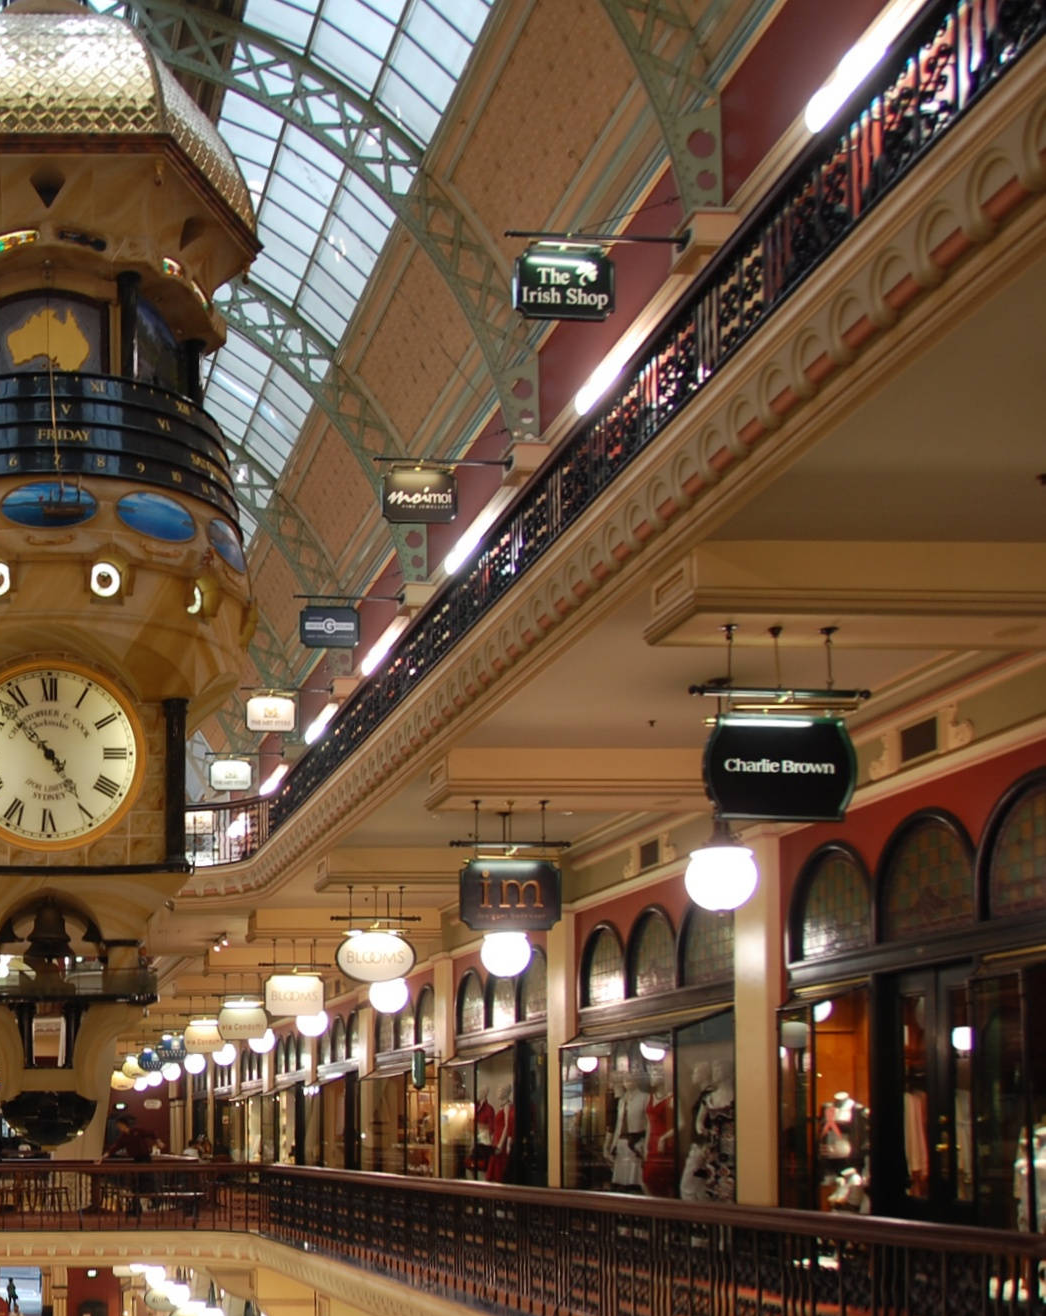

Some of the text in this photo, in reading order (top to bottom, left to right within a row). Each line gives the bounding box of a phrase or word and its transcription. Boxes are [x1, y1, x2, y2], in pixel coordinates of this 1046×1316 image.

[536, 267, 570, 285] The
[522, 286, 609, 310] Irish Shop
[90, 380, 105, 393] XI
[61, 403, 72, 415] V
[157, 419, 171, 432] VI
[38, 428, 91, 442] FRIDAY
[8, 455, 18, 467] 6
[96, 456, 106, 468] 8
[136, 461, 146, 473] 9
[171, 471, 182, 483] 10
[387, 486, 452, 505] moimoi
[41, 677, 58, 701] XII
[75, 687, 89, 709] I
[9, 708, 60, 740] CHSTOPHER
[94, 712, 118, 730] II
[103, 747, 127, 760] III
[724, 758, 835, 774] Charlie Brown
[33, 792, 66, 801] SYDNEY
[479, 869, 544, 909] im
[346, 950, 405, 965] BLOOMS
